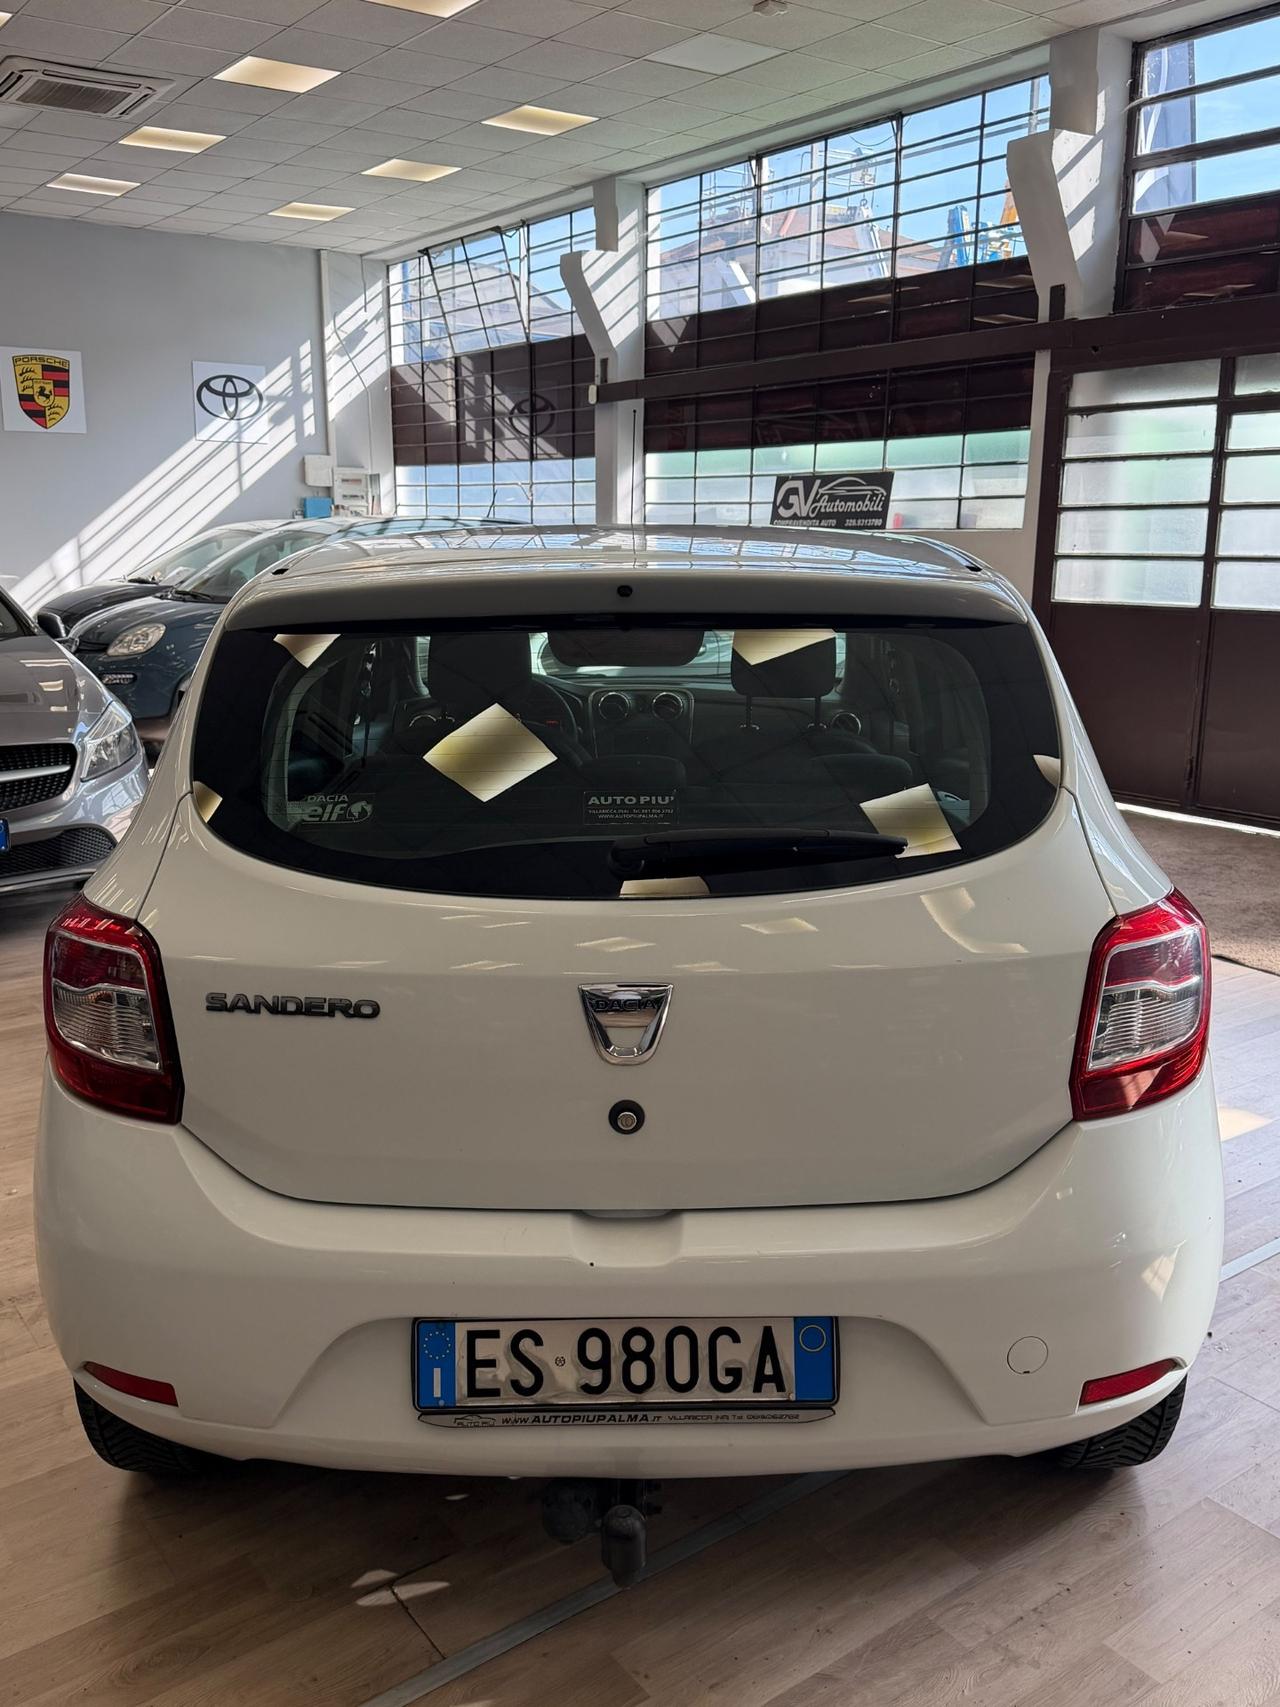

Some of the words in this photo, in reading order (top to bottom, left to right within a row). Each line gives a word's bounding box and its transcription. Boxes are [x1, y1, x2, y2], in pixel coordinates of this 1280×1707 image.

[15, 356, 68, 367] PORSCHE
[776, 479, 821, 518] GV
[809, 494, 885, 518] Automobili
[820, 519, 837, 528] AUTO
[307, 794, 349, 803] DACIA
[588, 796, 637, 805] AUTO
[303, 803, 348, 821] elf
[205, 991, 382, 1019] SANDERO
[594, 999, 657, 1012] DACIA
[466, 1328, 544, 1398] ES
[576, 1325, 787, 1396] 980GA
